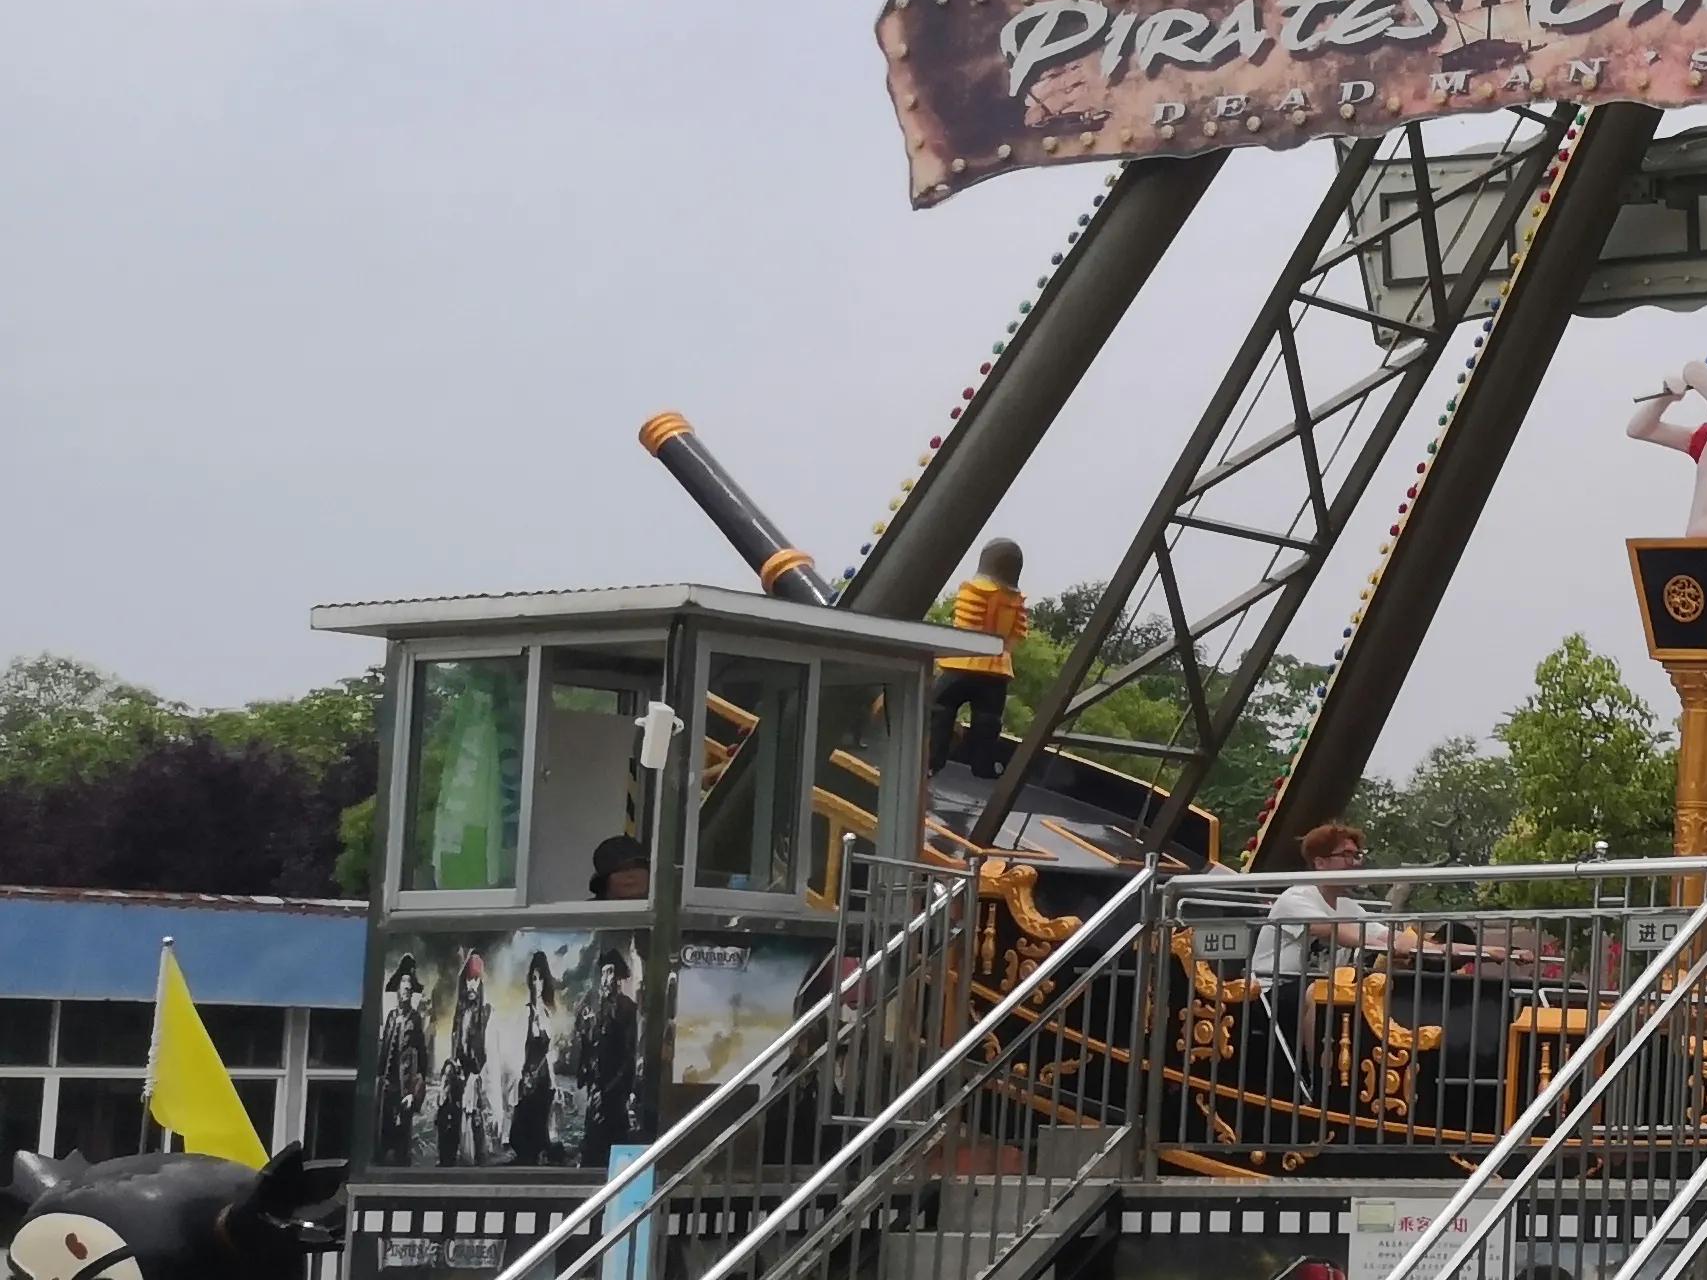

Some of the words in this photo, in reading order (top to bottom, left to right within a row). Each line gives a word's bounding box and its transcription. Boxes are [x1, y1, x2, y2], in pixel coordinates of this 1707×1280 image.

[1152, 80, 1375, 125] DEAD
[1639, 923, 1678, 942] 进口
[1204, 934, 1236, 951] 出口
[1399, 1216, 1468, 1233] 乘客知
